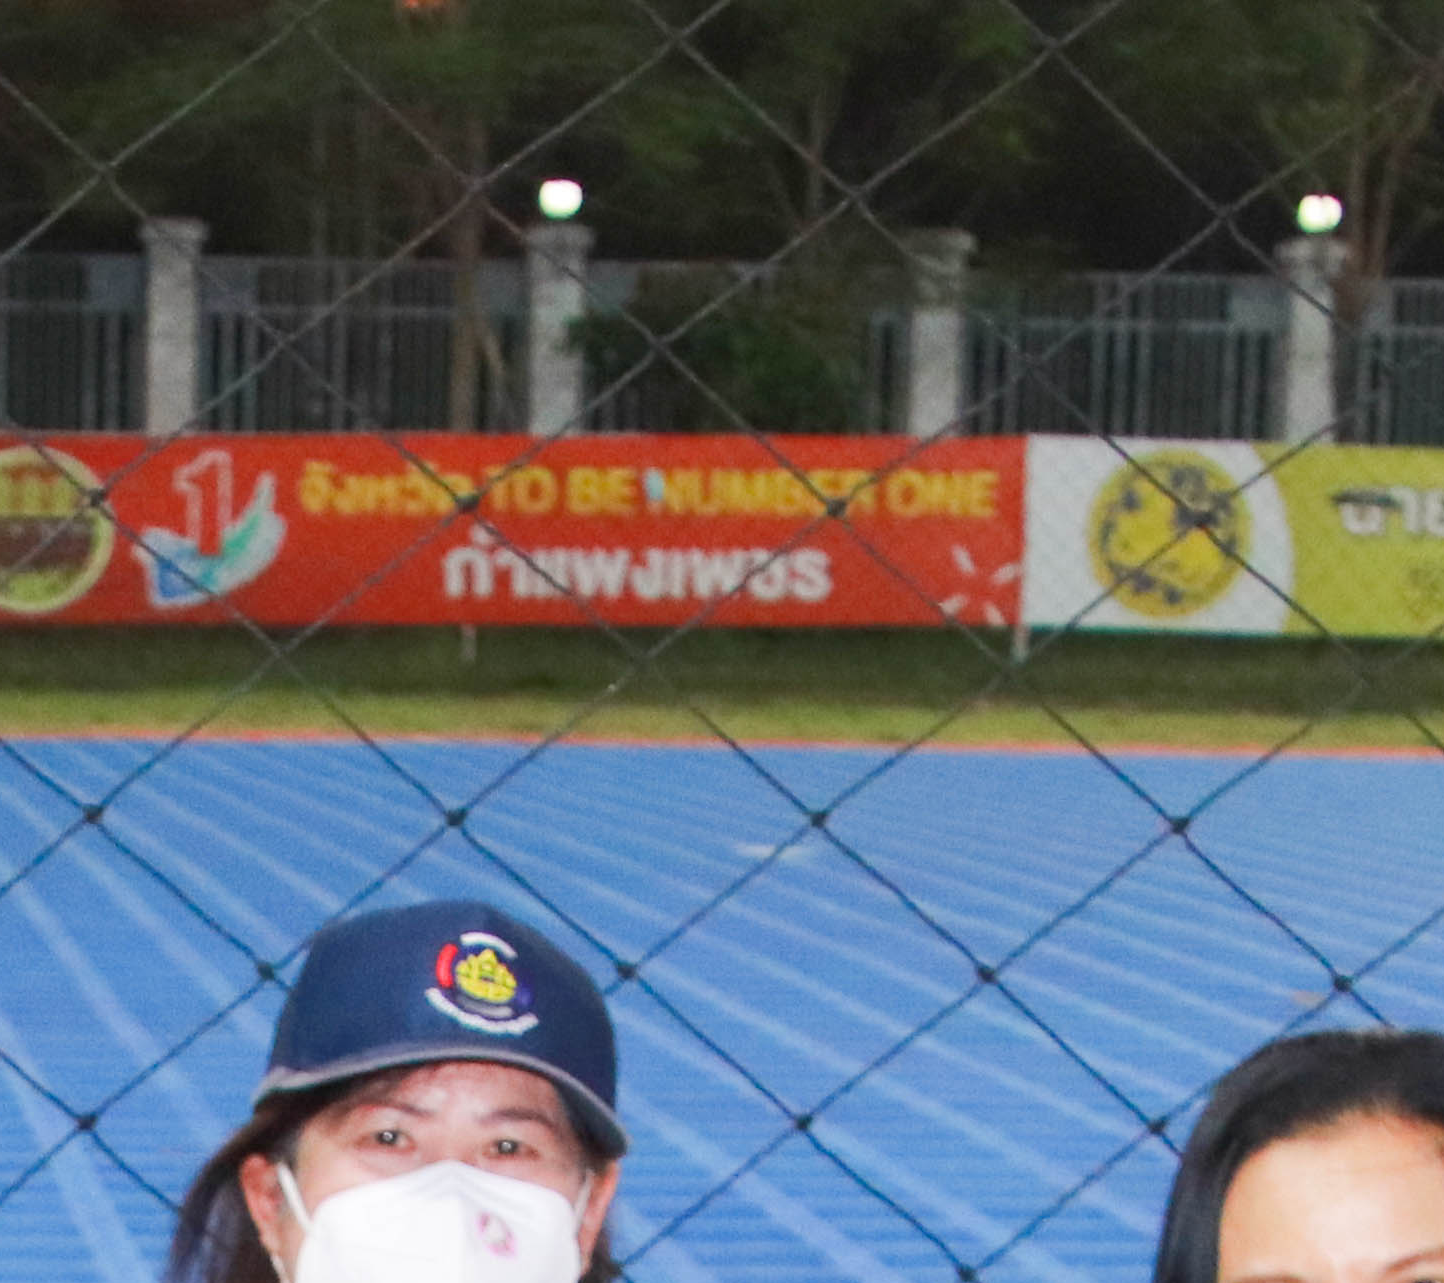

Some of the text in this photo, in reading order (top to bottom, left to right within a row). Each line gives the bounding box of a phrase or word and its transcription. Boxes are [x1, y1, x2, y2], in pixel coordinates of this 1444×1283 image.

[486, 466, 557, 512] TO
[567, 465, 635, 514] BE
[885, 469, 999, 519] ONE
